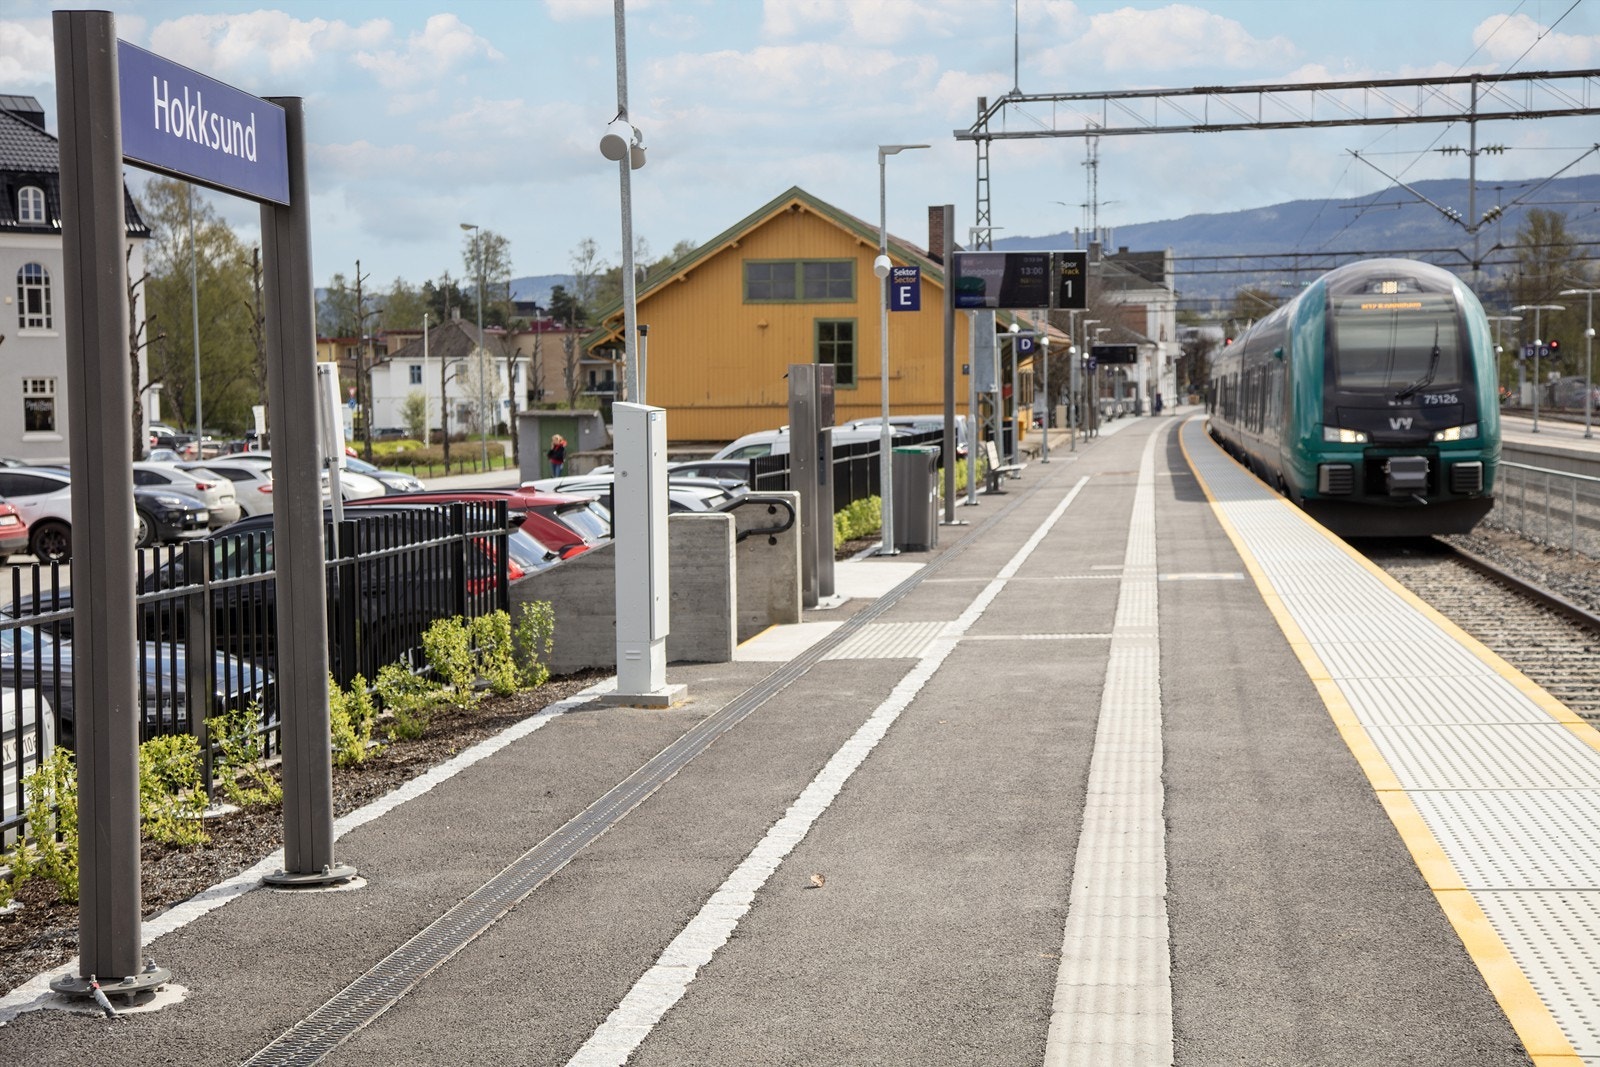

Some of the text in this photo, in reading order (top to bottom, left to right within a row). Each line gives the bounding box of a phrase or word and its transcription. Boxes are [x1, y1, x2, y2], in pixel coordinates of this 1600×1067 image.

[153, 75, 257, 163] Hokksund
[1060, 260, 1077, 269] Spor
[893, 268, 917, 276] Sektor
[1020, 266, 1044, 275] 13:00
[894, 276, 917, 284] Sector
[1064, 280, 1072, 298] 1
[900, 286, 912, 305] E
[1021, 338, 1032, 350] D
[1424, 394, 1458, 405] 75126
